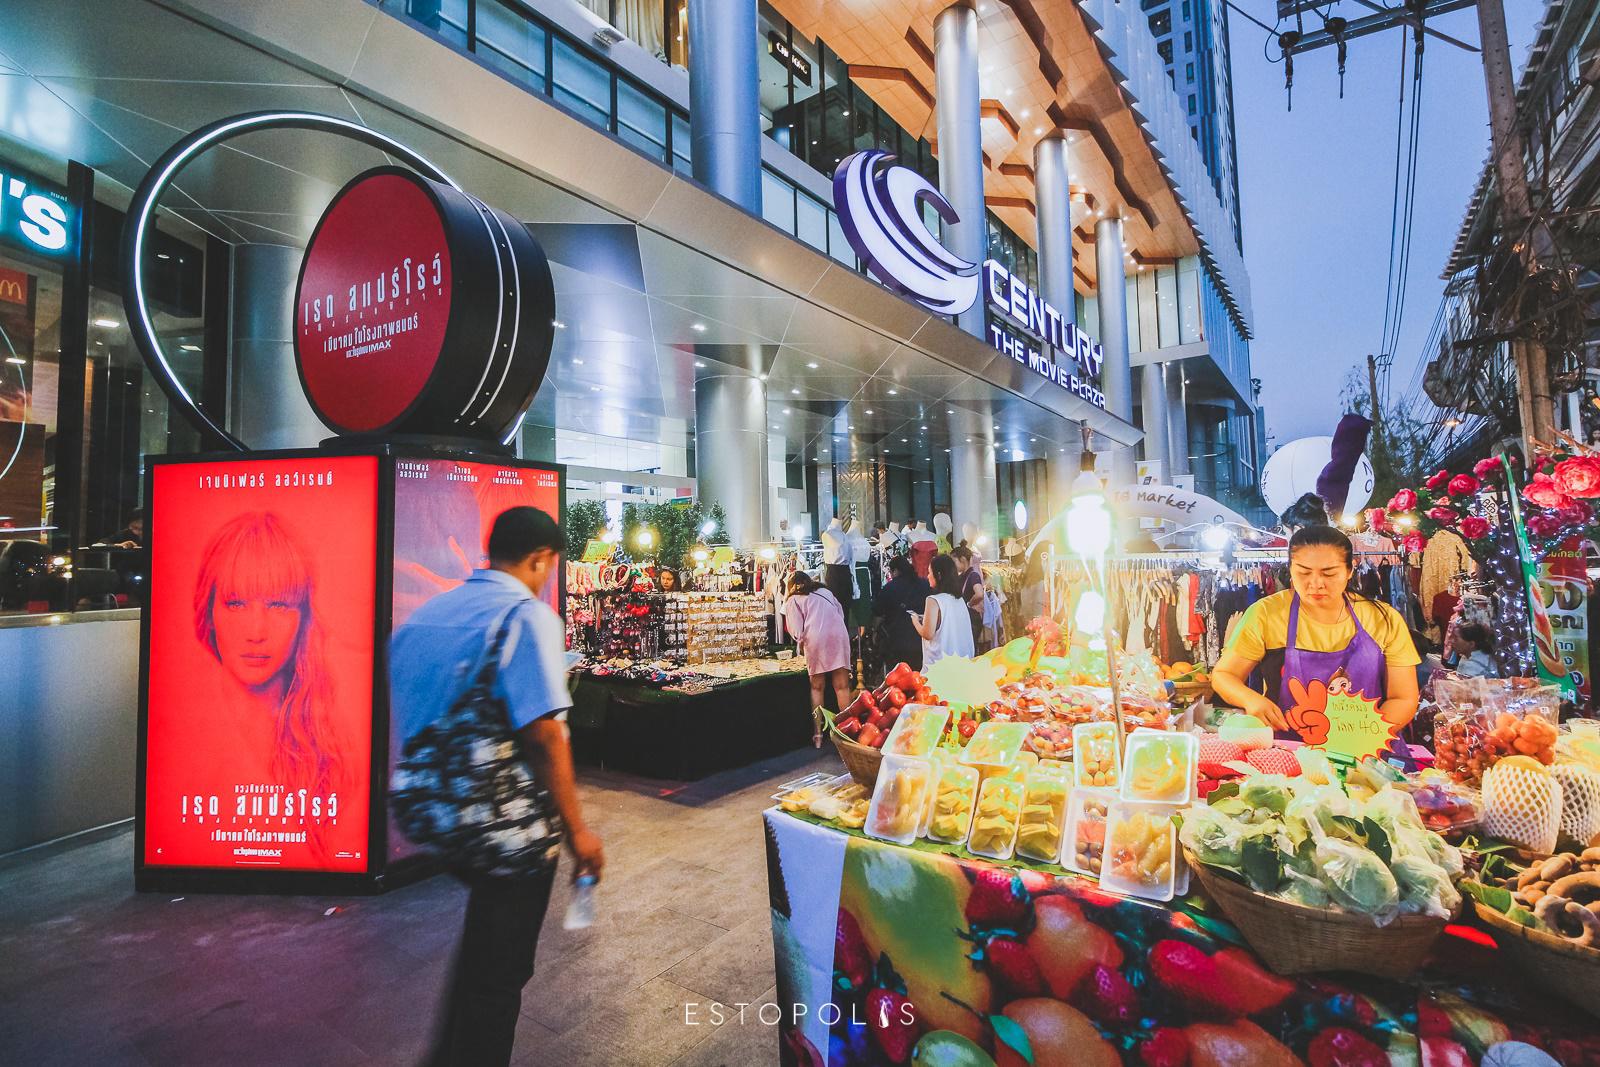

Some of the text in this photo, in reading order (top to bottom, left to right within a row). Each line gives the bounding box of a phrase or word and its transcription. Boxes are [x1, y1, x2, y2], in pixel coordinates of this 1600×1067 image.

[304, 252, 442, 326] เรด สแปร์โรว์
[983, 258, 1104, 377] CENTURY
[368, 339, 392, 353] IMAX
[990, 324, 1107, 411] THE MOVIE PLAZA
[199, 472, 265, 489] เจนนิเฟอร์
[1137, 490, 1197, 514] Market
[181, 789, 338, 817] เรด สแปร์โรว์
